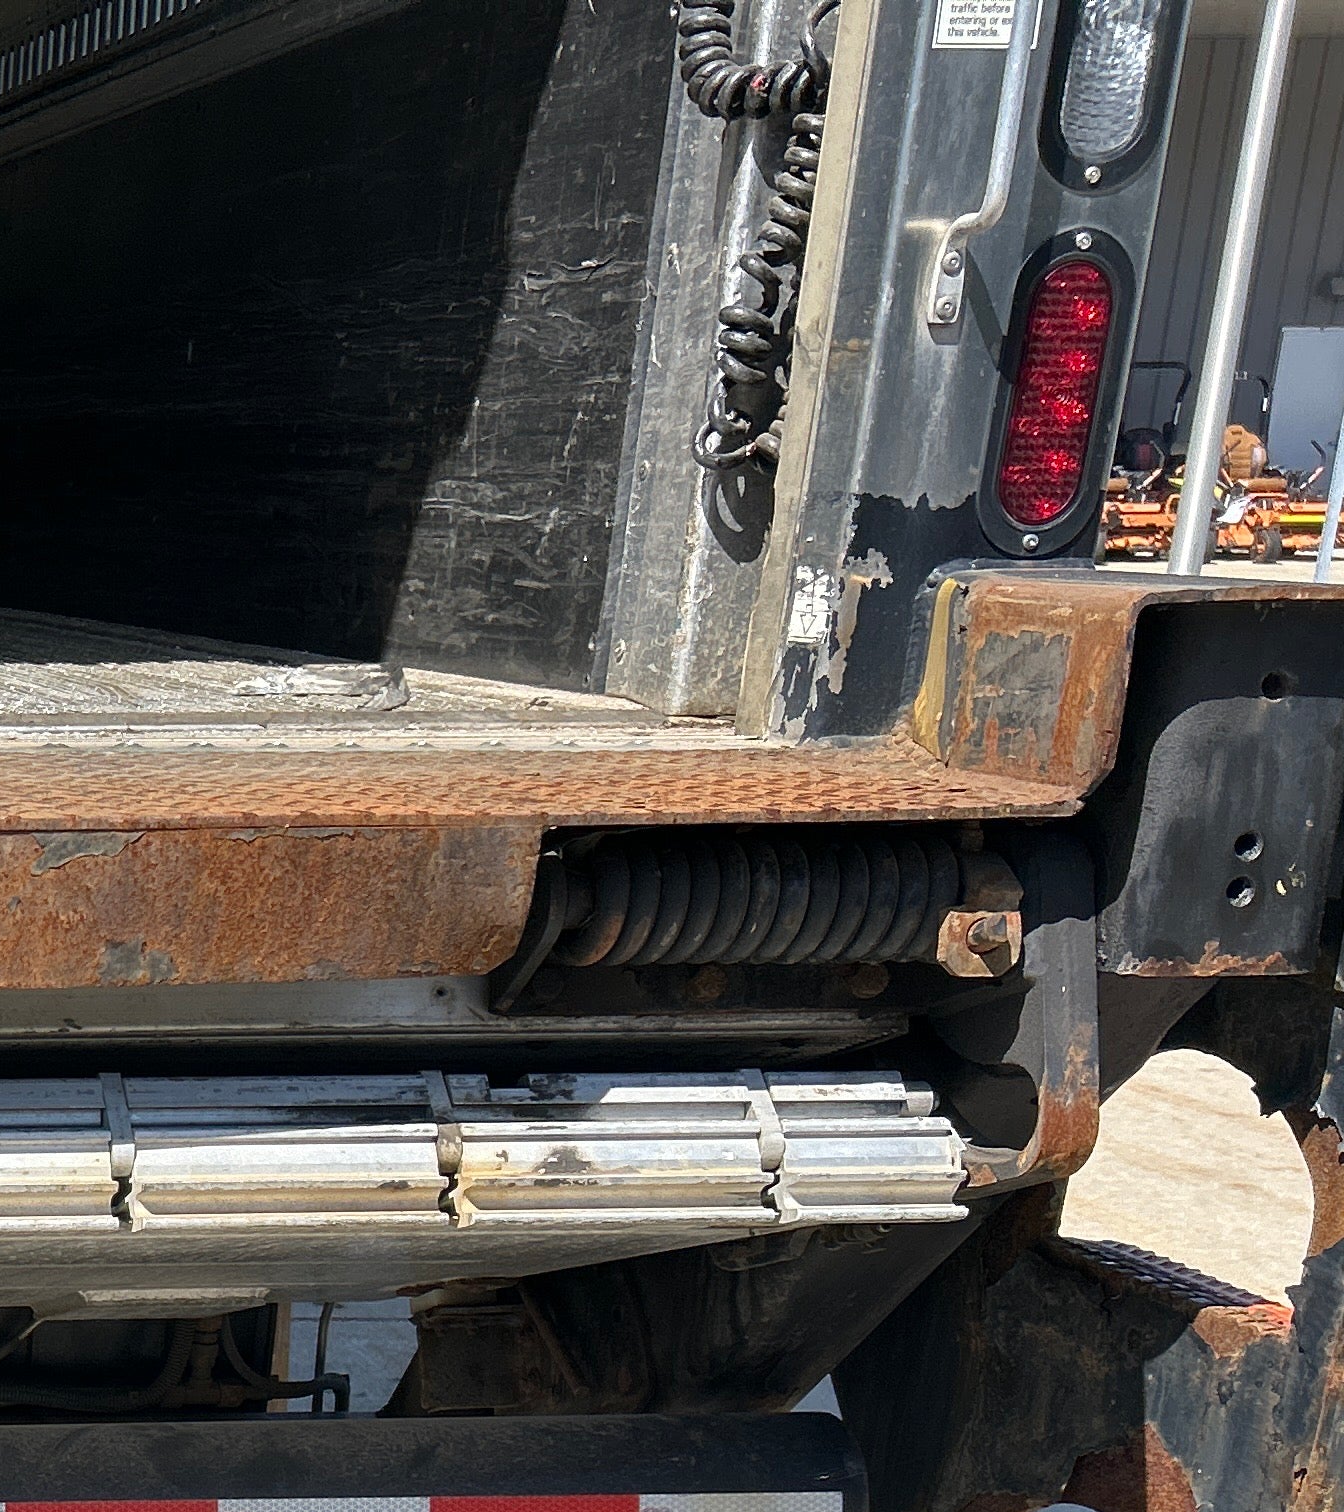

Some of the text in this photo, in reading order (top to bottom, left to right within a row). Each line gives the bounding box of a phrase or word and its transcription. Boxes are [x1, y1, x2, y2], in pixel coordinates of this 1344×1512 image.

[951, 3, 1010, 13] traffic before
[949, 16, 986, 27] entering
